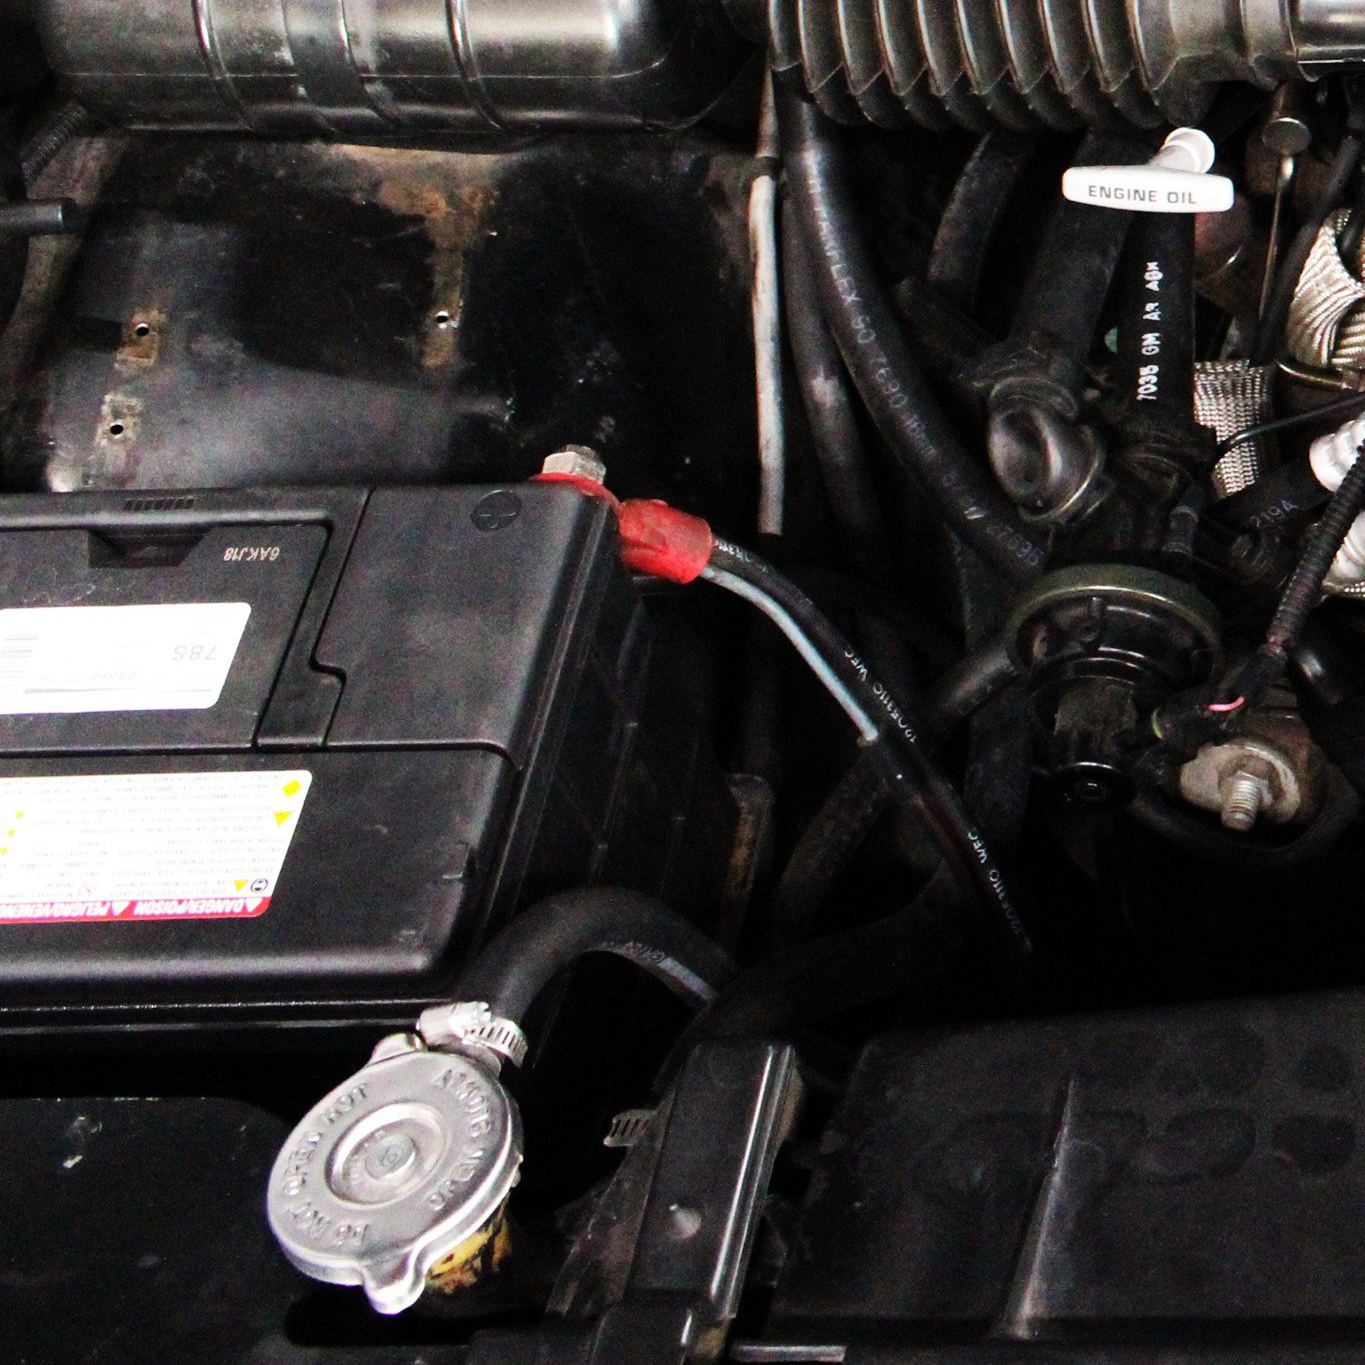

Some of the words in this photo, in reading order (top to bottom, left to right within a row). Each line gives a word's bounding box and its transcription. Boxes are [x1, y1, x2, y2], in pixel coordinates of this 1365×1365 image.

[1088, 185, 1158, 203] ENGINE
[1167, 191, 1197, 205] OIL
[1141, 333, 1160, 356] GM
